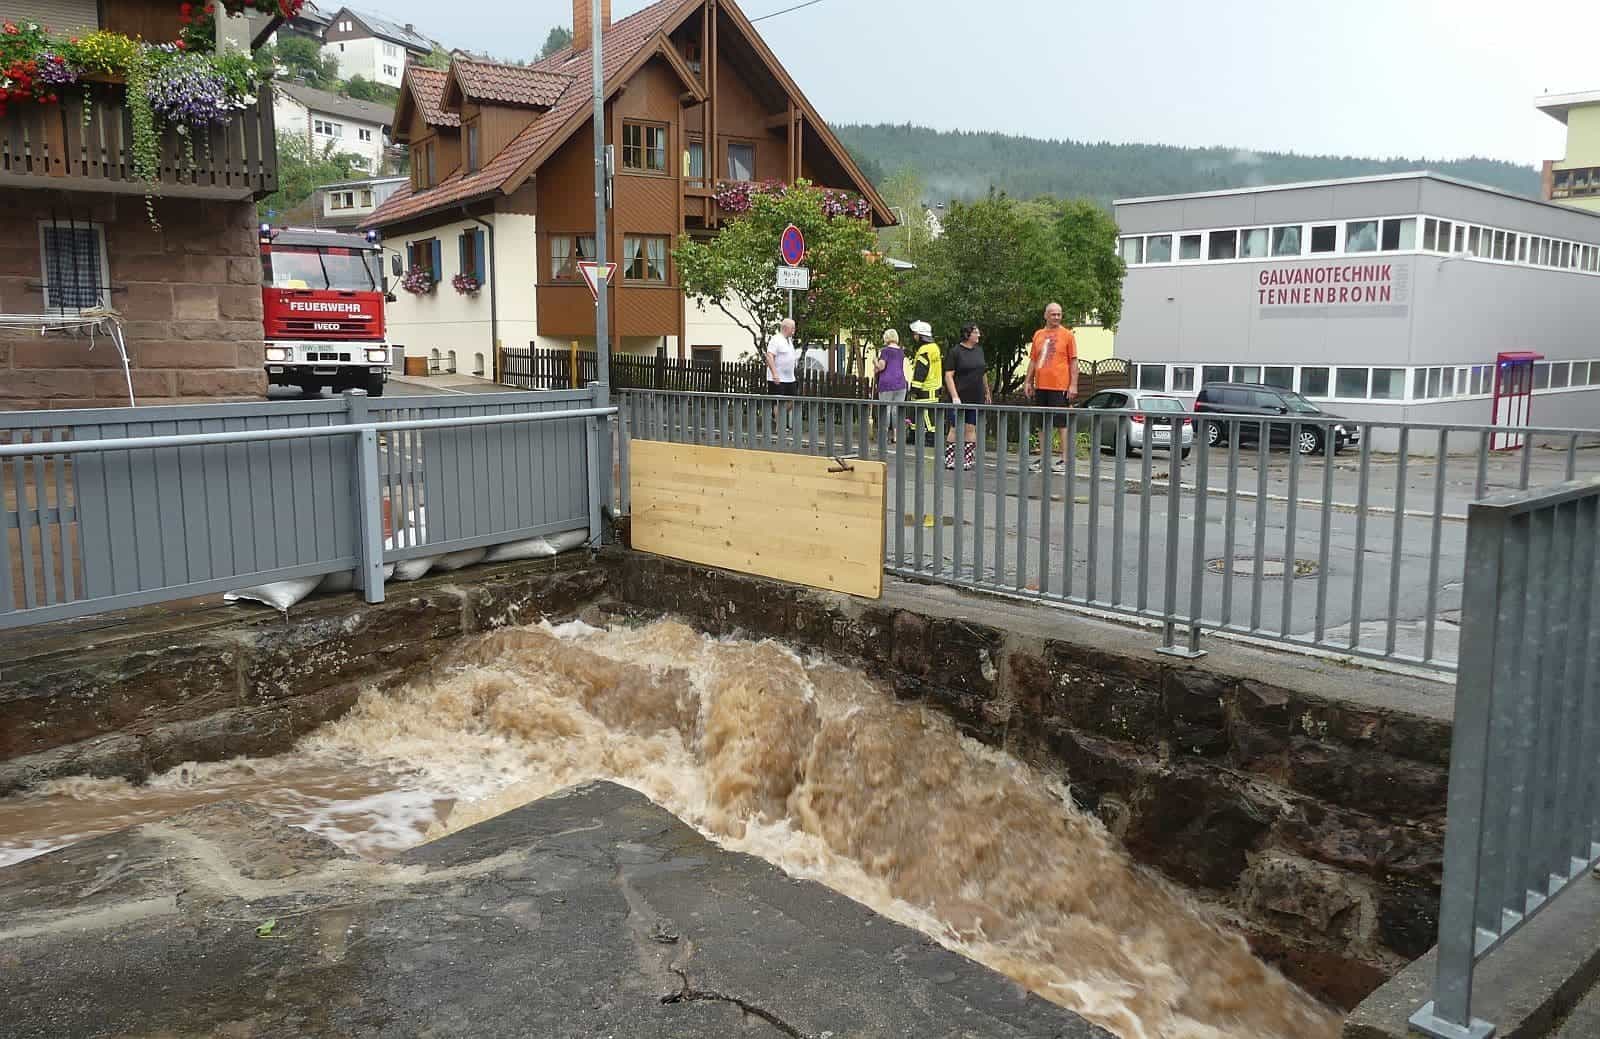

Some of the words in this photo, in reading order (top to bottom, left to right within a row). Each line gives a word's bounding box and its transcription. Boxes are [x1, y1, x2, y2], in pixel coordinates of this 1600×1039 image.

[1259, 264, 1391, 285] GALVANOTECHNIK
[1258, 285, 1391, 305] TENNENBRONN
[290, 301, 361, 312] FEUERWEHR
[314, 322, 340, 330] IVECO
